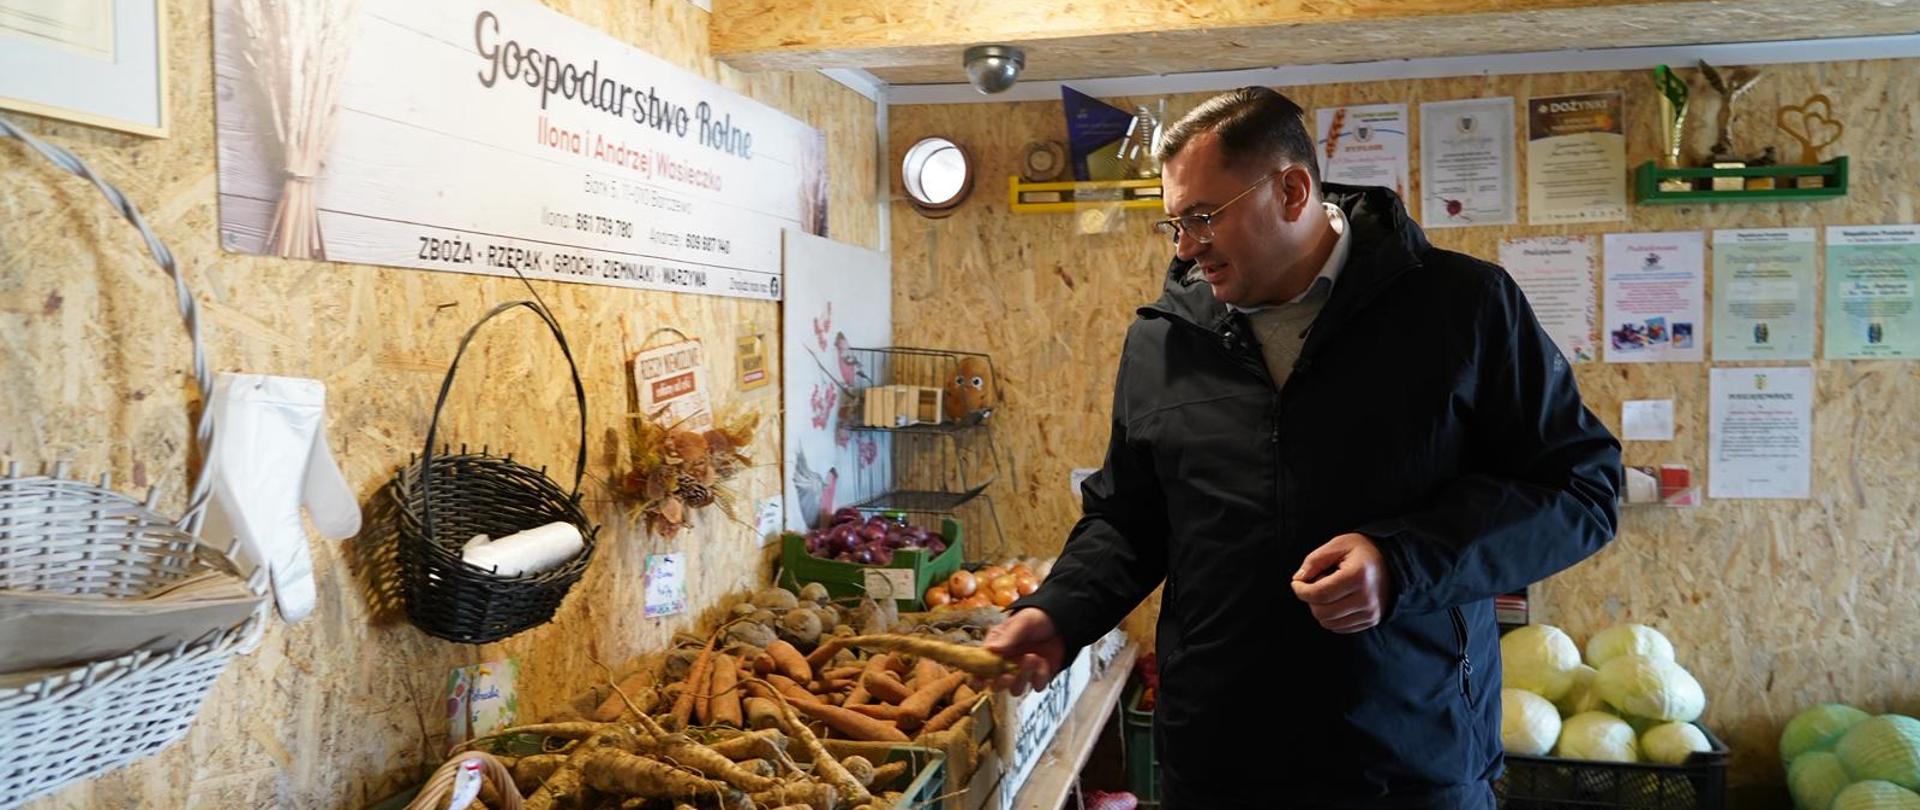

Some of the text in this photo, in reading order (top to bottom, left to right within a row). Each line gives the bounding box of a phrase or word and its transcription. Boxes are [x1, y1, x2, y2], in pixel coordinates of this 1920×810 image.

[474, 10, 753, 160] Gospodarstwo Rolne
[537, 115, 581, 154] Ilona
[585, 130, 591, 157] i
[594, 134, 652, 180] Andrzej
[576, 212, 593, 231] 661
[596, 216, 612, 236] 739
[616, 219, 633, 239] 780
[418, 235, 707, 288] ZBOŻA RZEPAK GROCH ZIEMNIAKI WARZYWA
